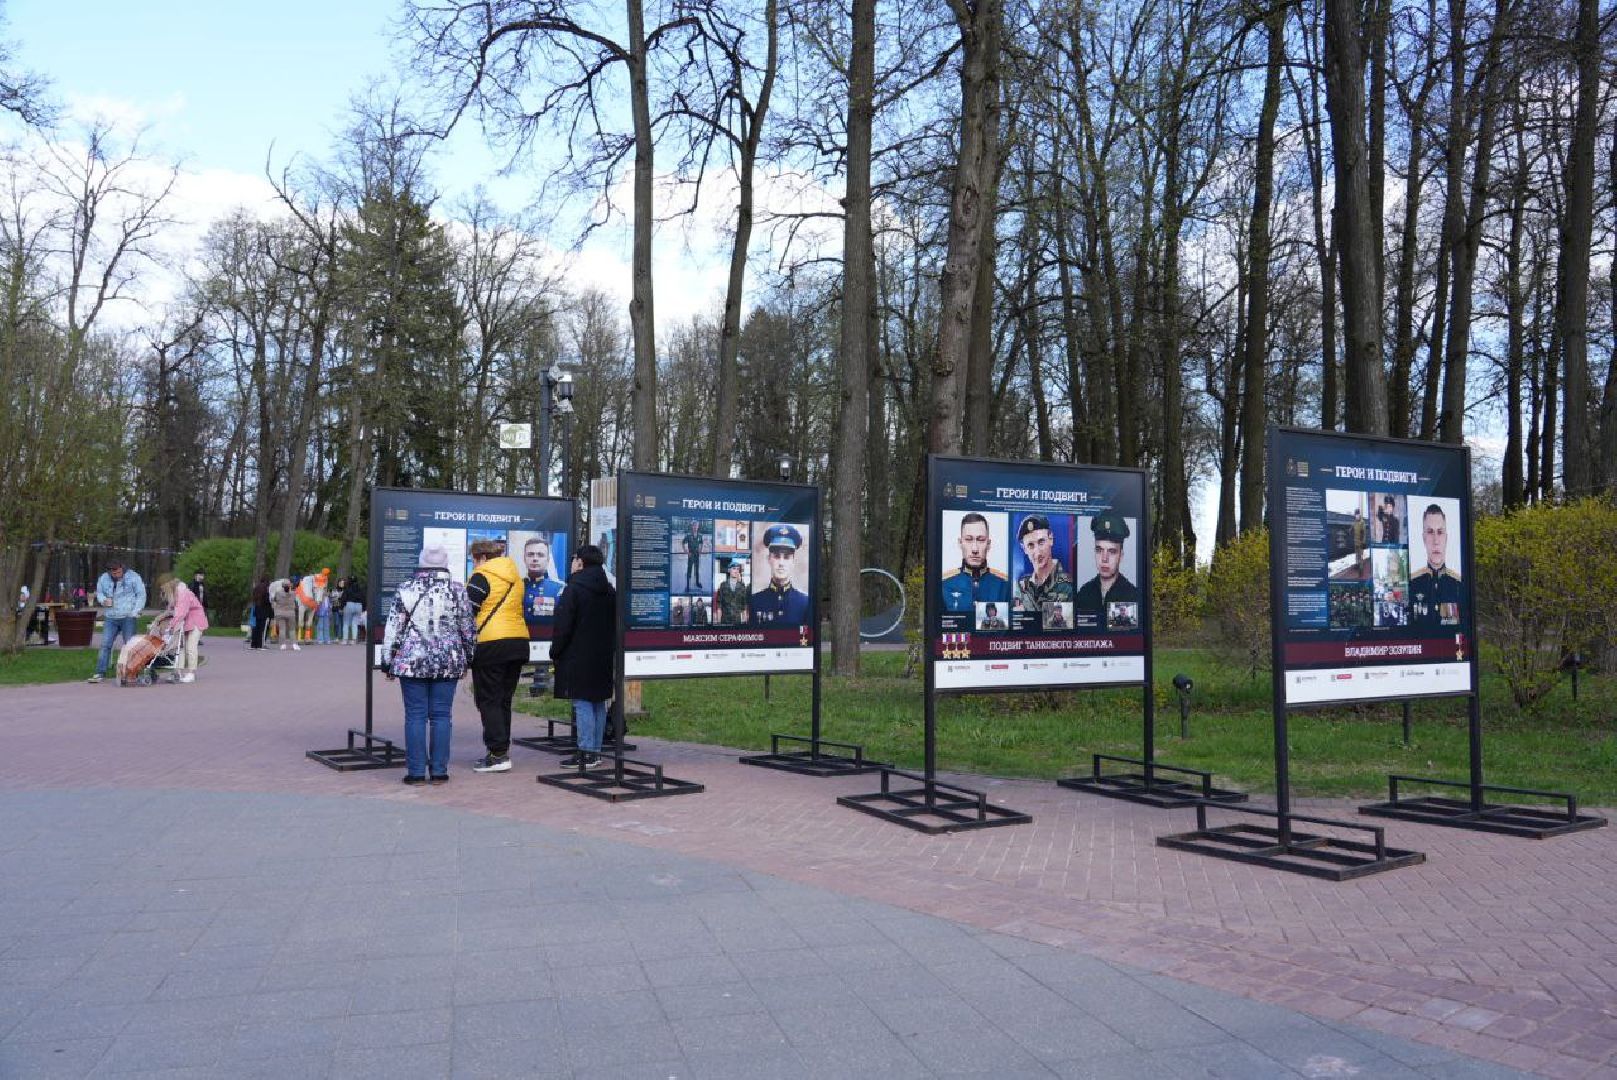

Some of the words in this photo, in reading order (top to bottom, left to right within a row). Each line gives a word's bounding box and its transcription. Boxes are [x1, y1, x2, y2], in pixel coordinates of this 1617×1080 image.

[1335, 466, 1365, 478] ГЕРОИ
[1367, 468, 1374, 479] И
[1375, 469, 1417, 483] ПОДВИГИ
[996, 487, 1030, 499] ГЕРОИ
[1031, 490, 1039, 500] И
[1041, 490, 1087, 502] ПОДВИГИ
[682, 499, 712, 510] ГЕРОИ
[714, 501, 722, 511] И
[722, 501, 765, 512] ПОДВИГИ
[434, 511, 466, 521] ГЕРОИ
[476, 513, 521, 524] ПОДВИГИ
[989, 641, 1023, 651] ПОДВИГ
[1024, 640, 1072, 650] ТАНКОВОГО
[1344, 645, 1388, 657] ВЛАДИМИР
